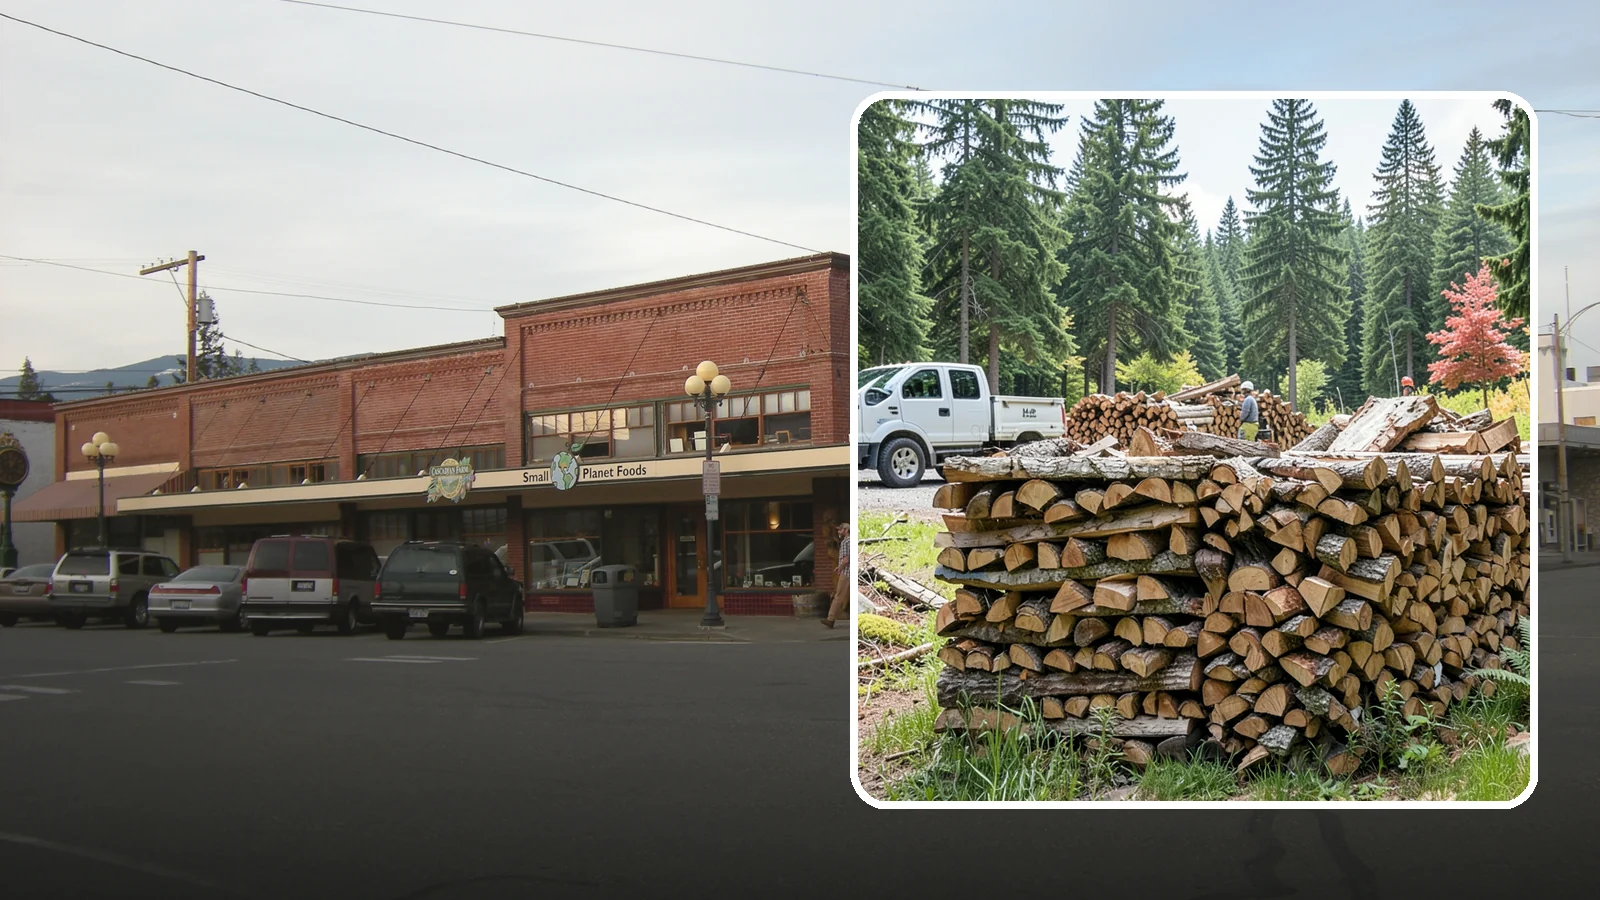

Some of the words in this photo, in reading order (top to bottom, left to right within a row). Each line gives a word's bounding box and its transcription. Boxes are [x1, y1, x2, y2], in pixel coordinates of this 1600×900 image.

[523, 470, 549, 483] Small
[583, 467, 614, 479] Planet
[617, 464, 647, 477] Foods
